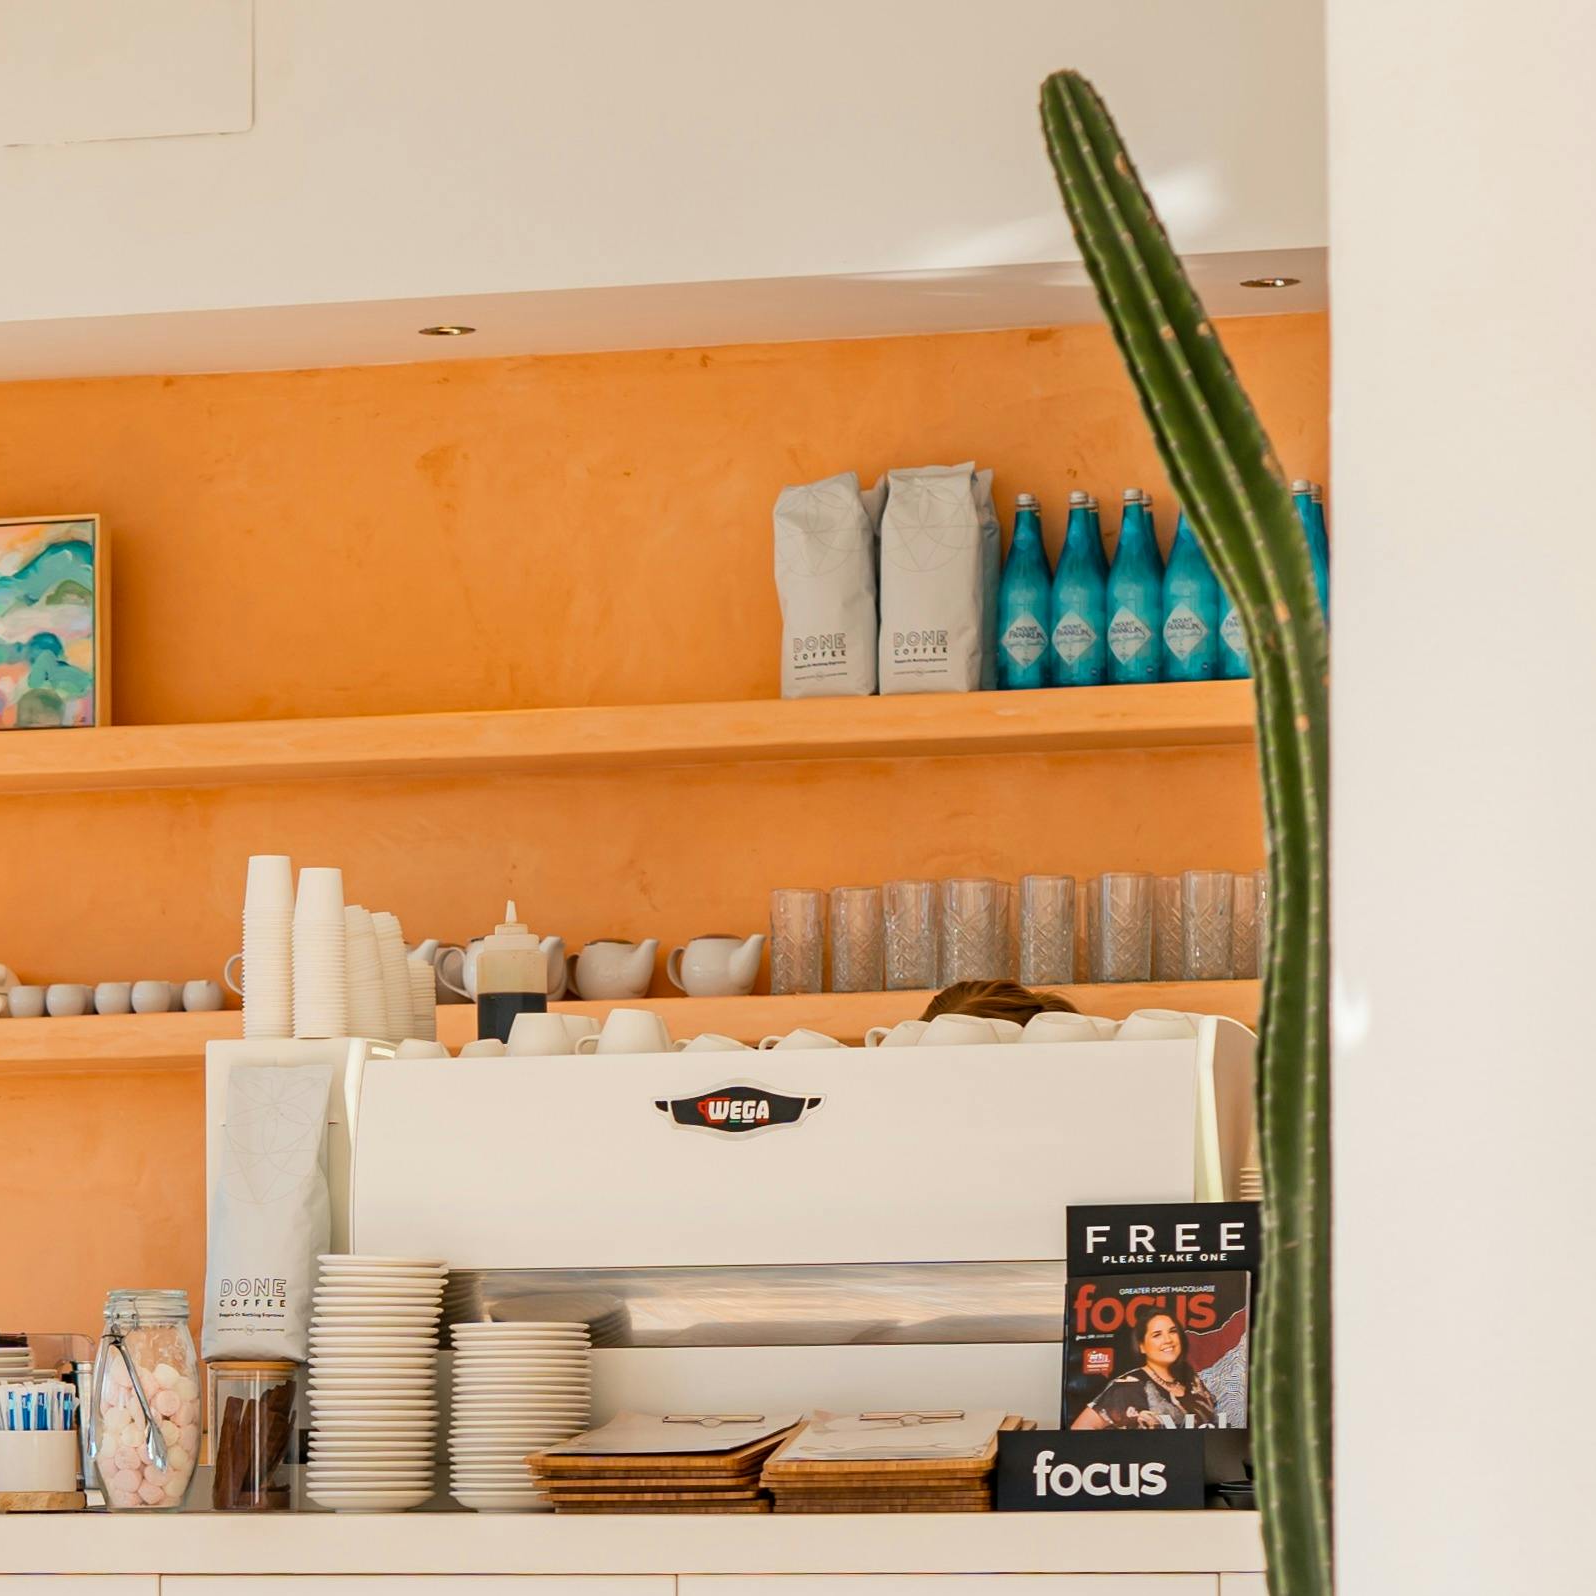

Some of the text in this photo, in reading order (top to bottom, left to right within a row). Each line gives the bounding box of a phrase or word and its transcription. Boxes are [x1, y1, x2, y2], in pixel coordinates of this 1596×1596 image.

[793, 633, 846, 653] DONE
[893, 630, 948, 648] DONE
[793, 650, 846, 661] COFFEE
[894, 647, 947, 656] COFFEE
[708, 1100, 770, 1120] WEGA
[1086, 1222, 1245, 1254] FREE
[1102, 1253, 1228, 1264] PLEASE TAKE ONE
[220, 1278, 287, 1297] DONE
[1151, 1286, 1170, 1294] PORT
[219, 1299, 286, 1308] COFFEE
[1033, 1450, 1168, 1498] focus
